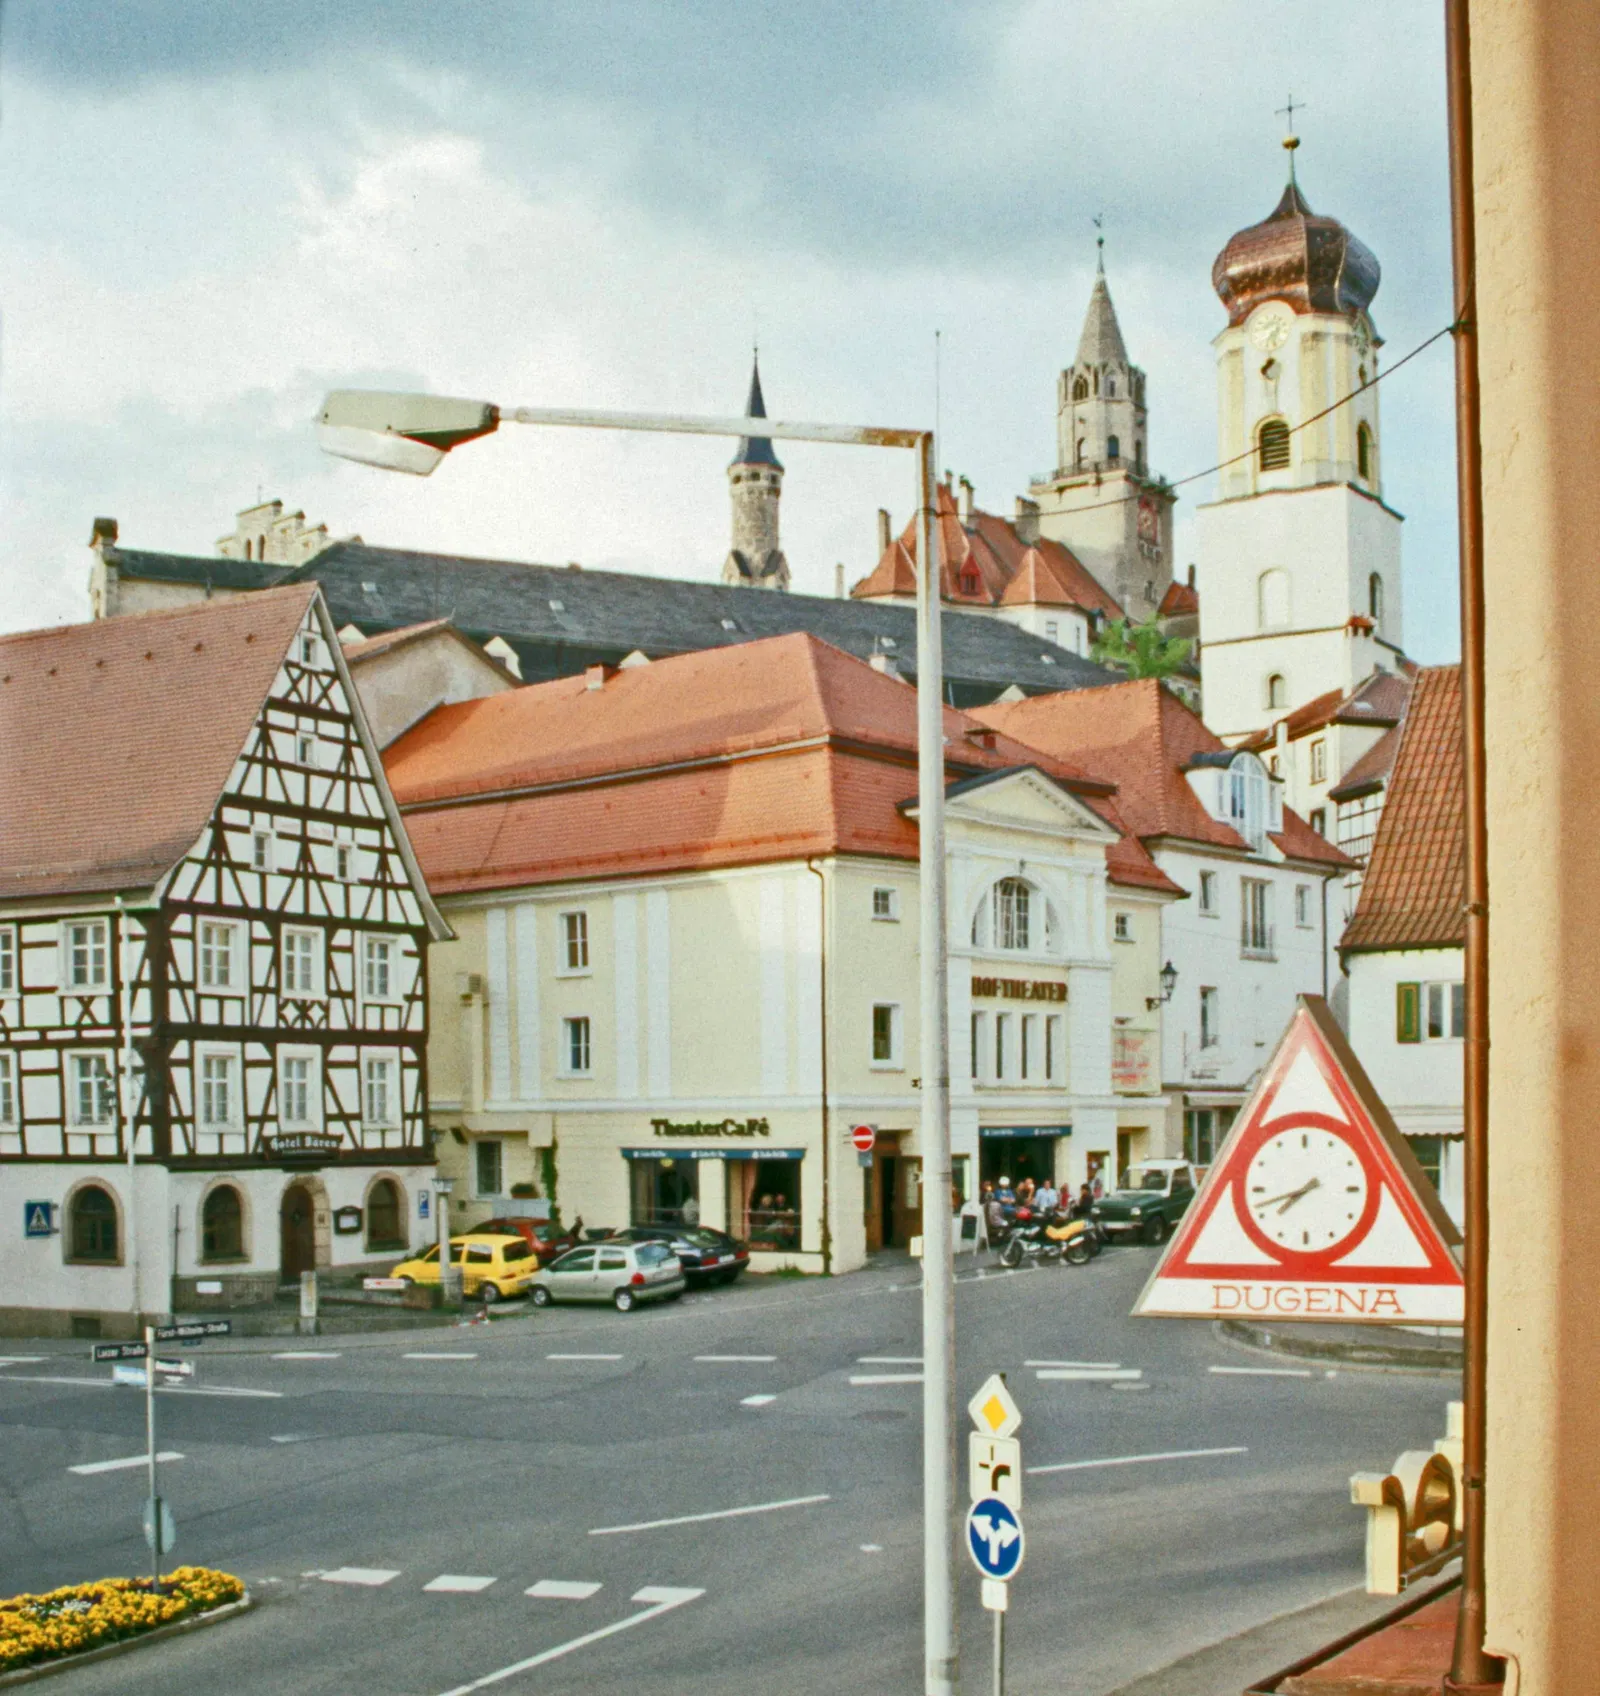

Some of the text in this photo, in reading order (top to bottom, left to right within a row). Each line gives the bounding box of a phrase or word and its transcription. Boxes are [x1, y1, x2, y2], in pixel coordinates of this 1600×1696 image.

[972, 976, 1068, 1002] HOFTHEATER
[270, 1135, 300, 1151] Hotel
[1212, 1284, 1404, 1315] DUGENA
